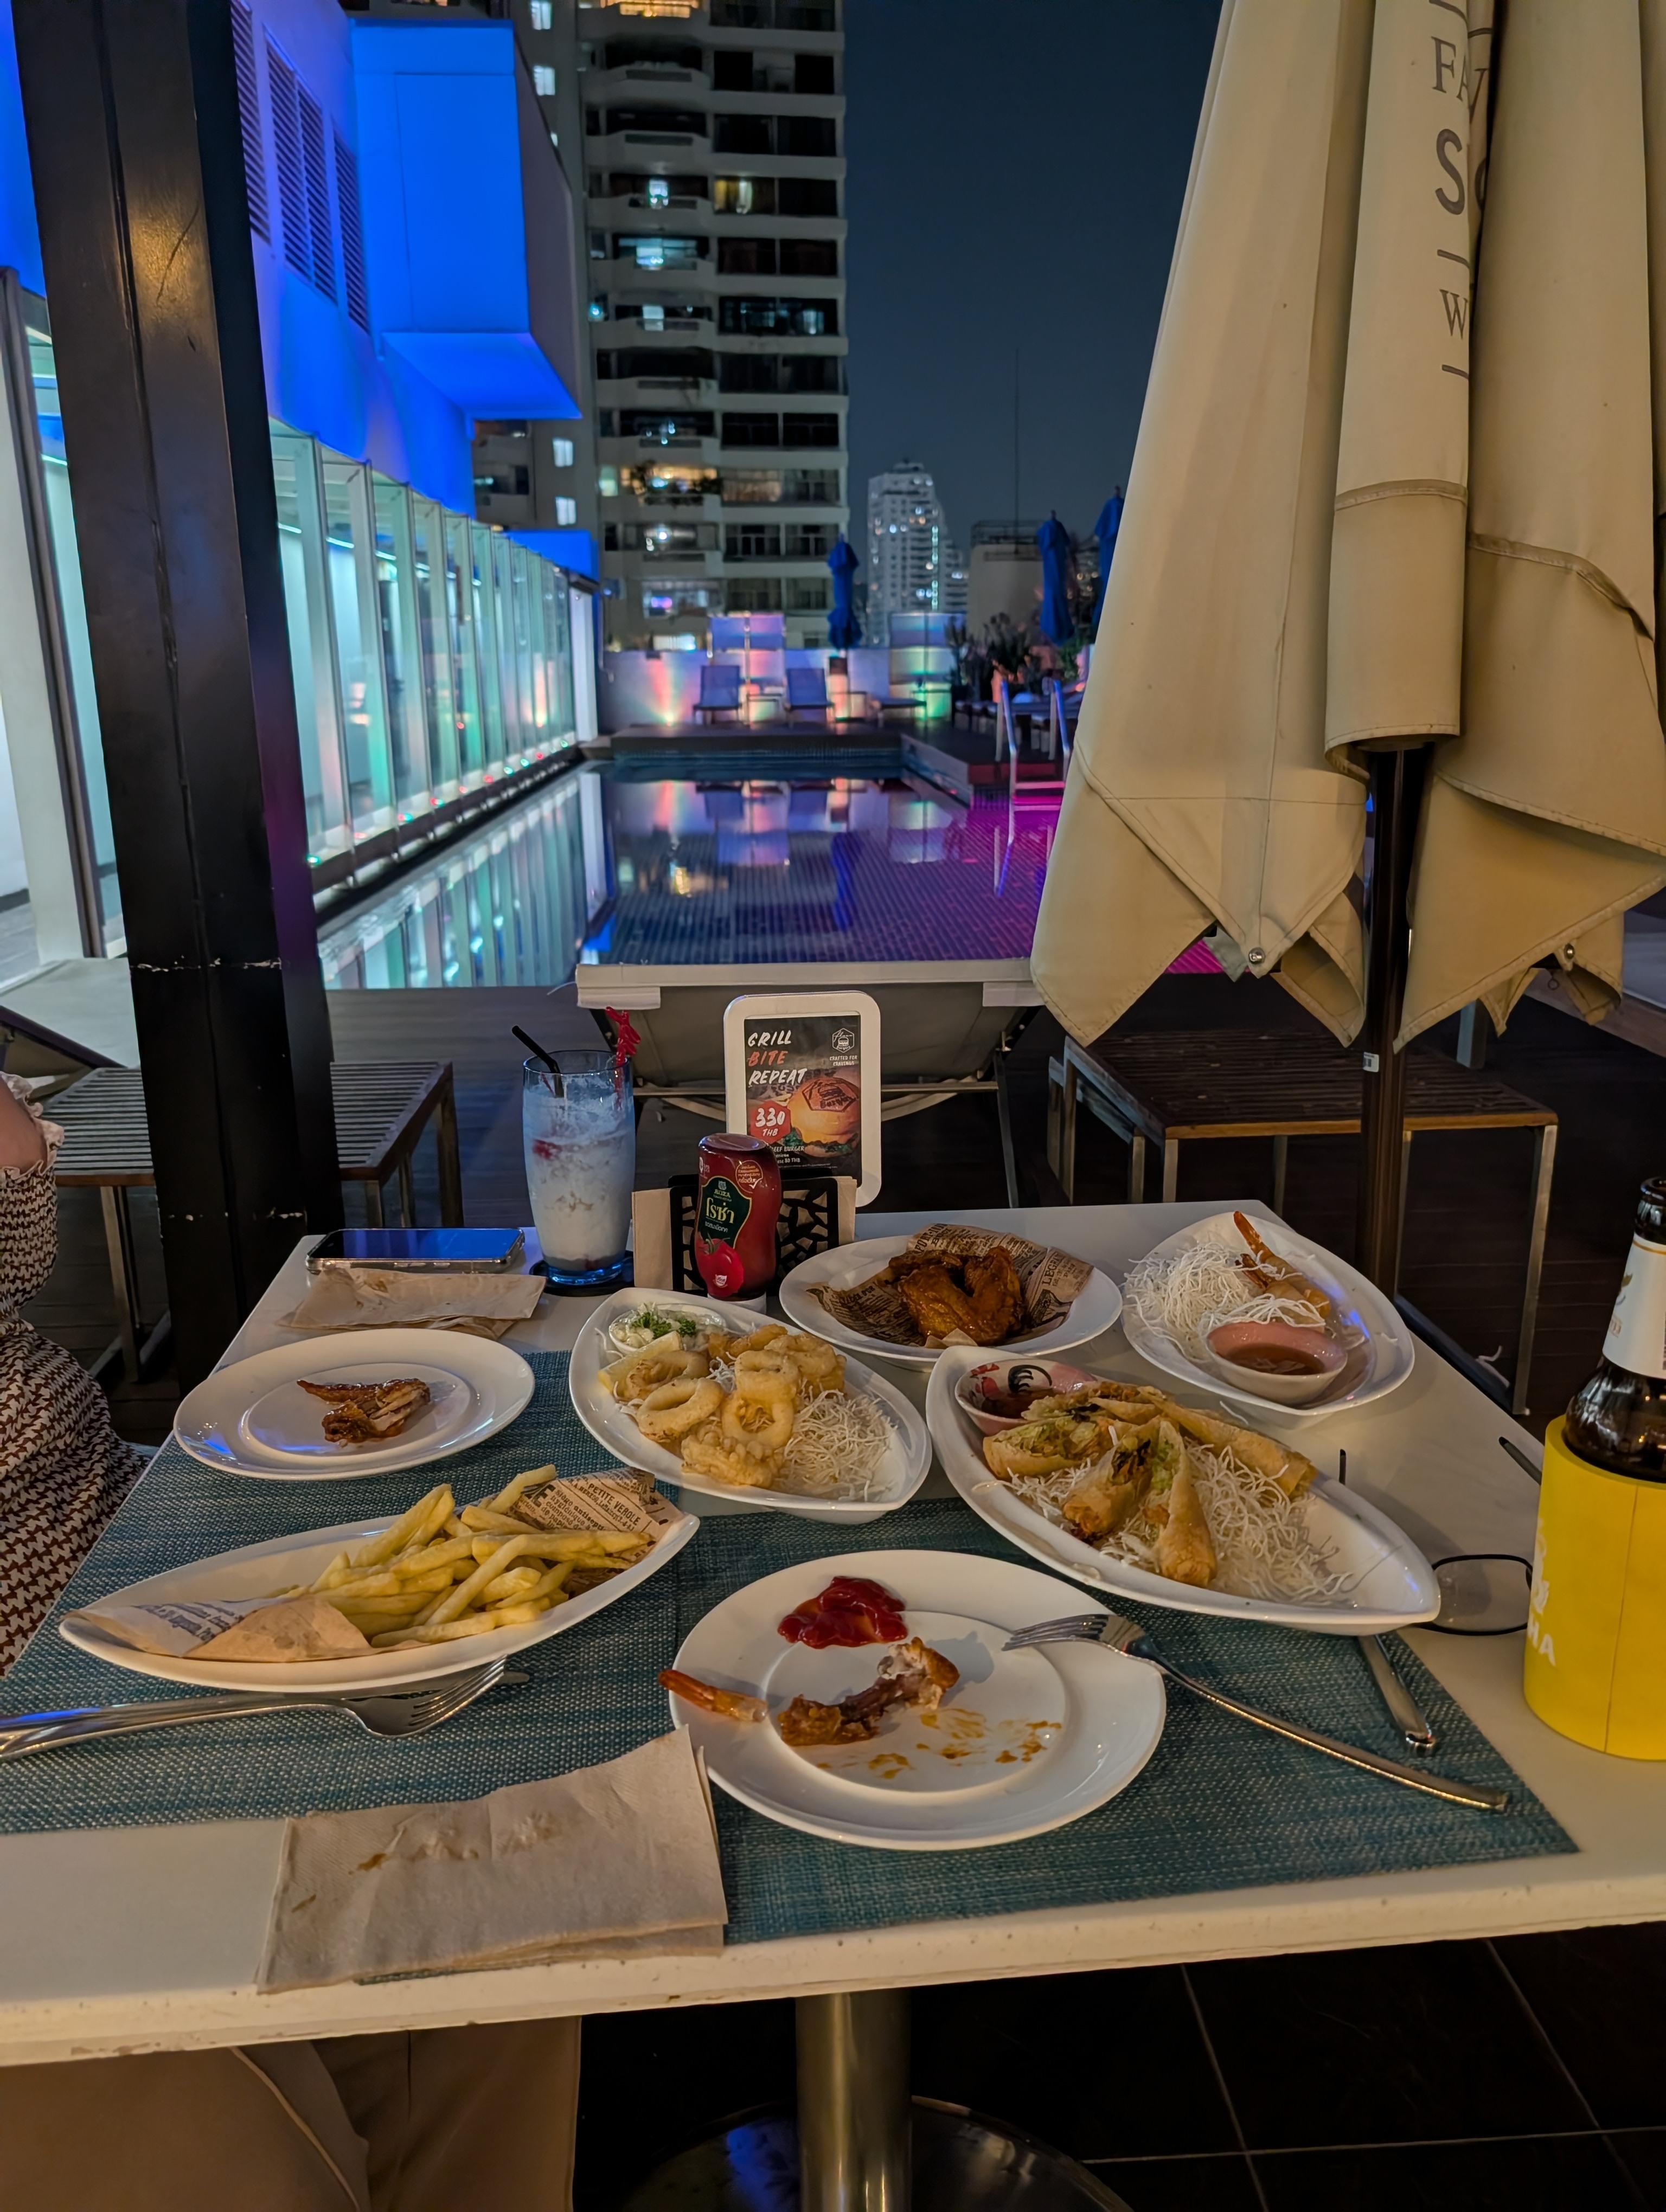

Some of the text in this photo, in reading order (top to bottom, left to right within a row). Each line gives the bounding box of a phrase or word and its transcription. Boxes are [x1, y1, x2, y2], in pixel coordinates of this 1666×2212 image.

[748, 1030, 791, 1047] GRILL
[748, 1050, 788, 1067] BITE
[748, 1068, 808, 1085] REPEAT
[755, 1108, 785, 1127] 330
[762, 1128, 778, 1136] THB
[588, 1483, 615, 1505] PETITE
